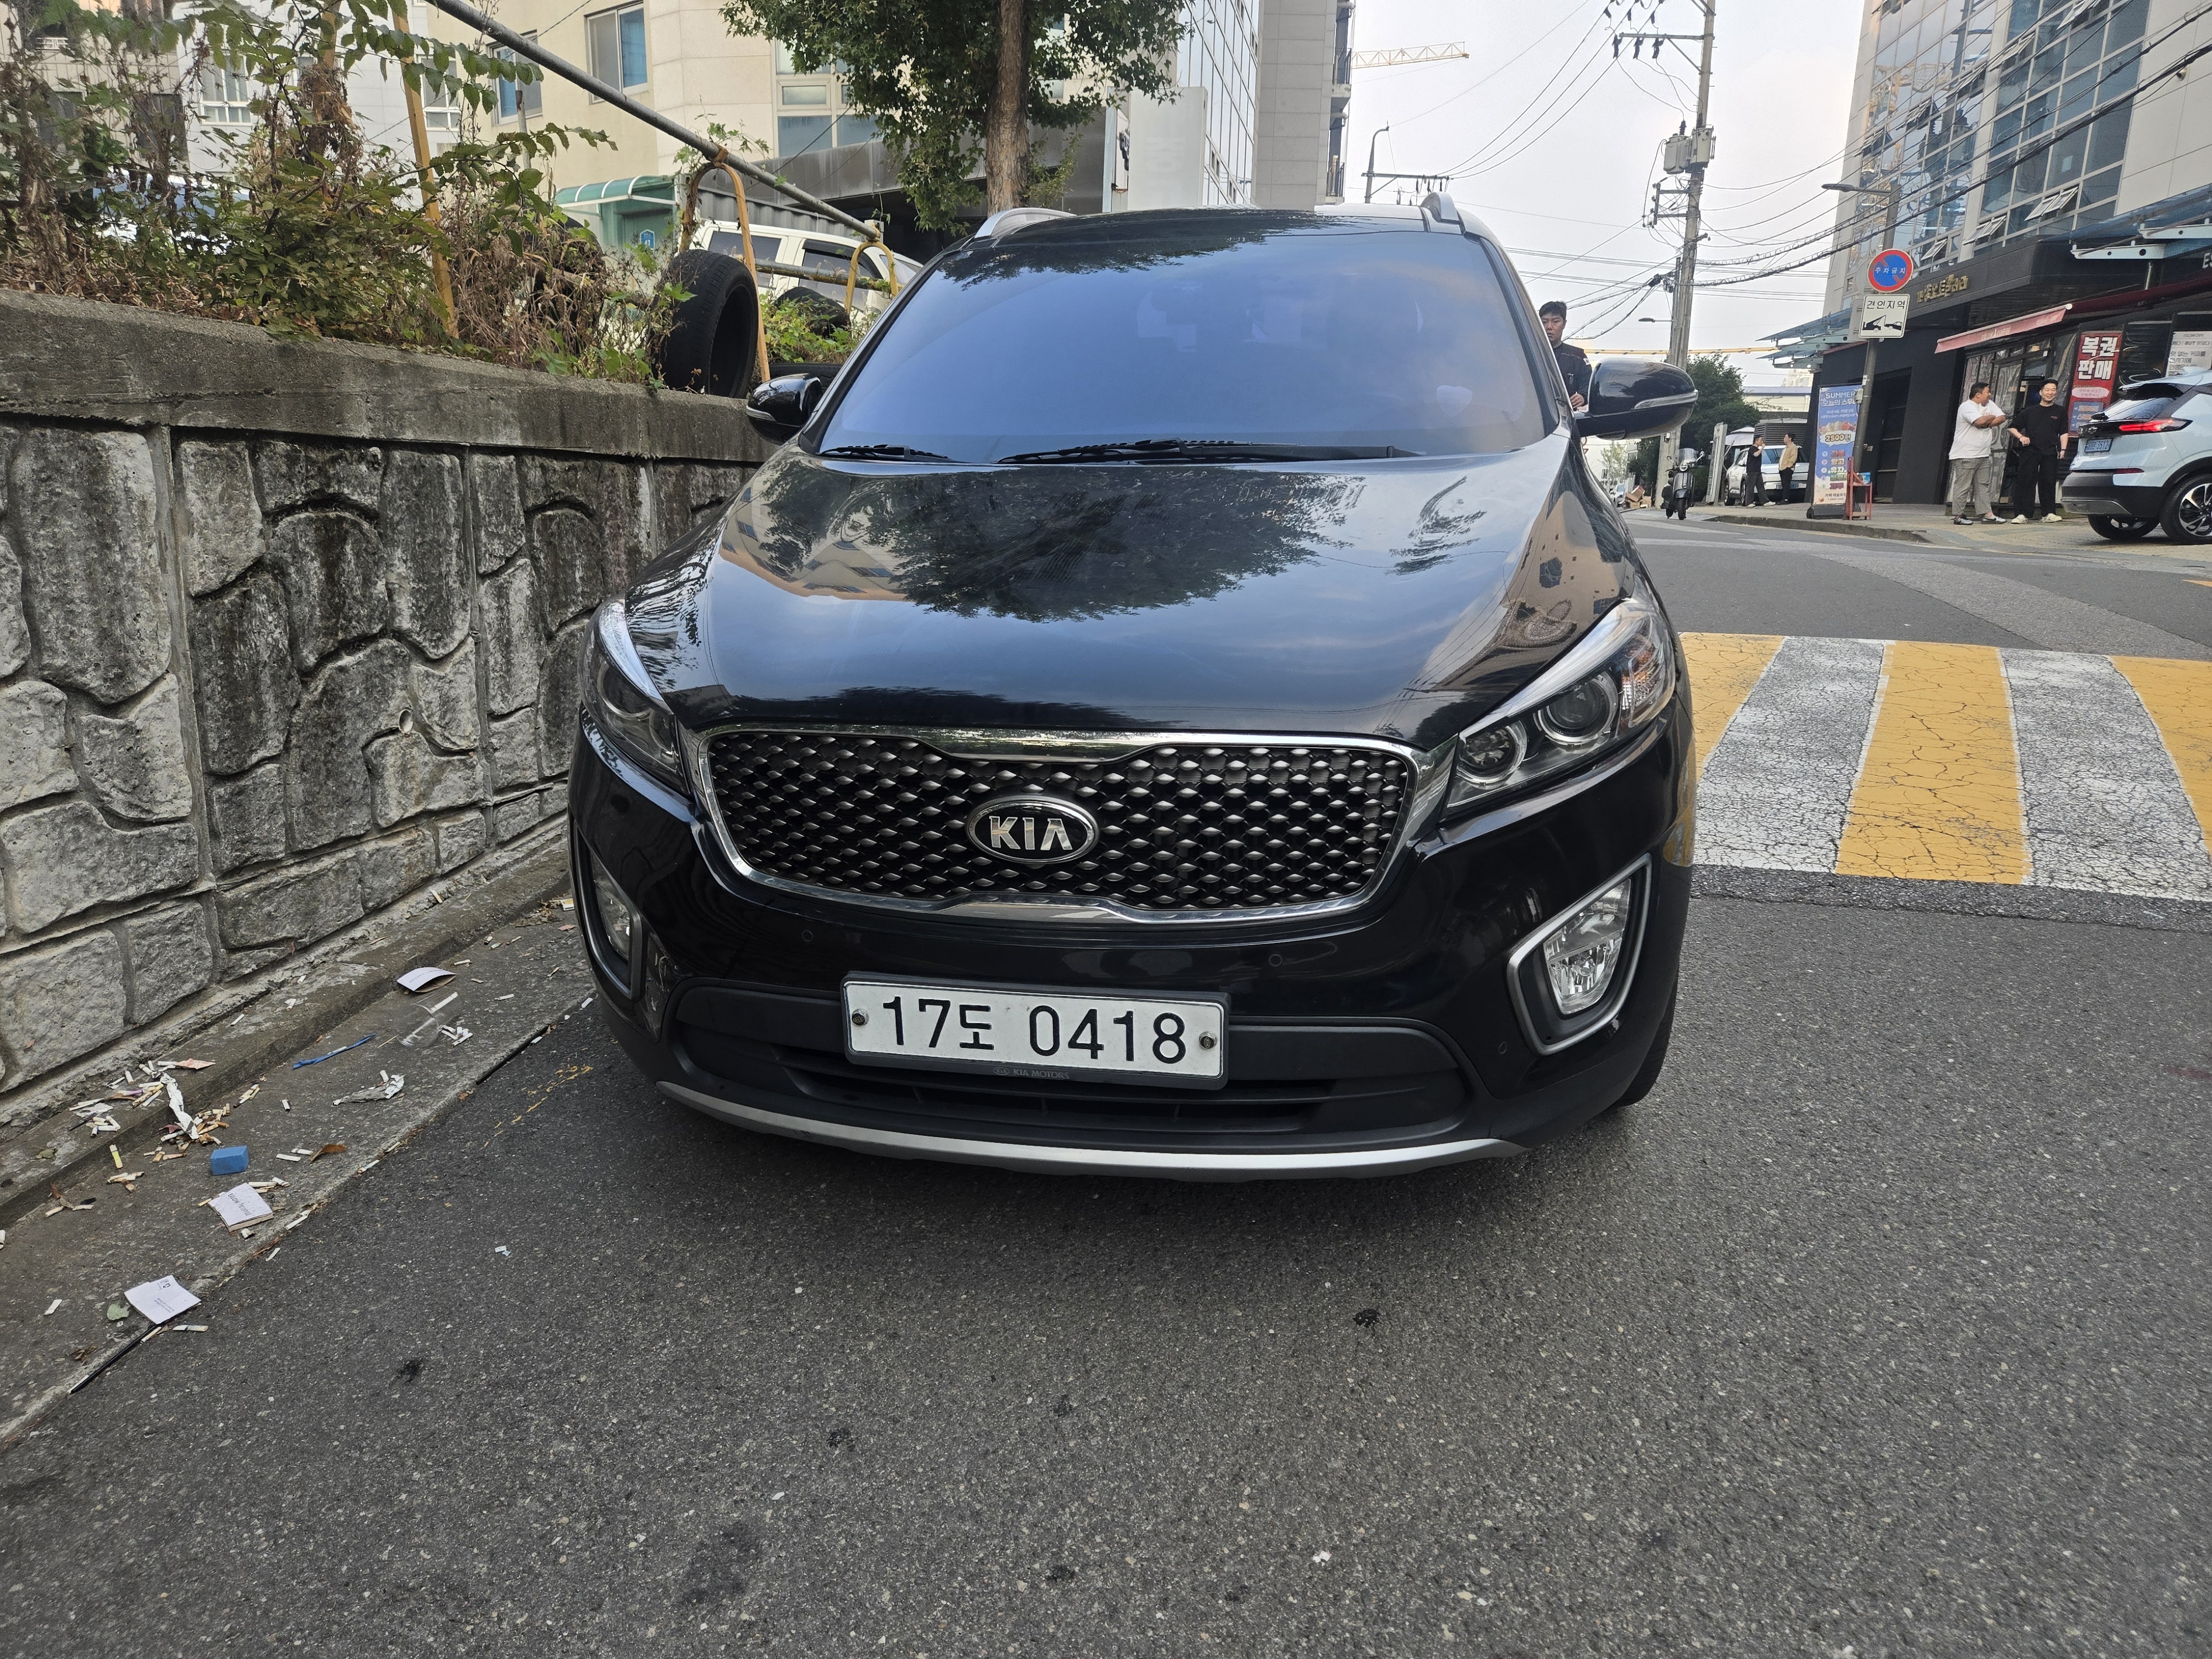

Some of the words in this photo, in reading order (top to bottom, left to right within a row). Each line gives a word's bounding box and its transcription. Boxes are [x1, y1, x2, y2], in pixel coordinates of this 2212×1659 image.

[1866, 300, 1906, 310] 견인지역
[2081, 337, 2118, 357] 복권
[2078, 360, 2113, 380] 판매
[1825, 434, 1851, 442] 2500원
[989, 816, 1073, 851] KIA
[883, 996, 994, 1050] 17도
[1029, 1005, 1186, 1064] 0418
[1031, 1070, 1070, 1078] MOTORS
